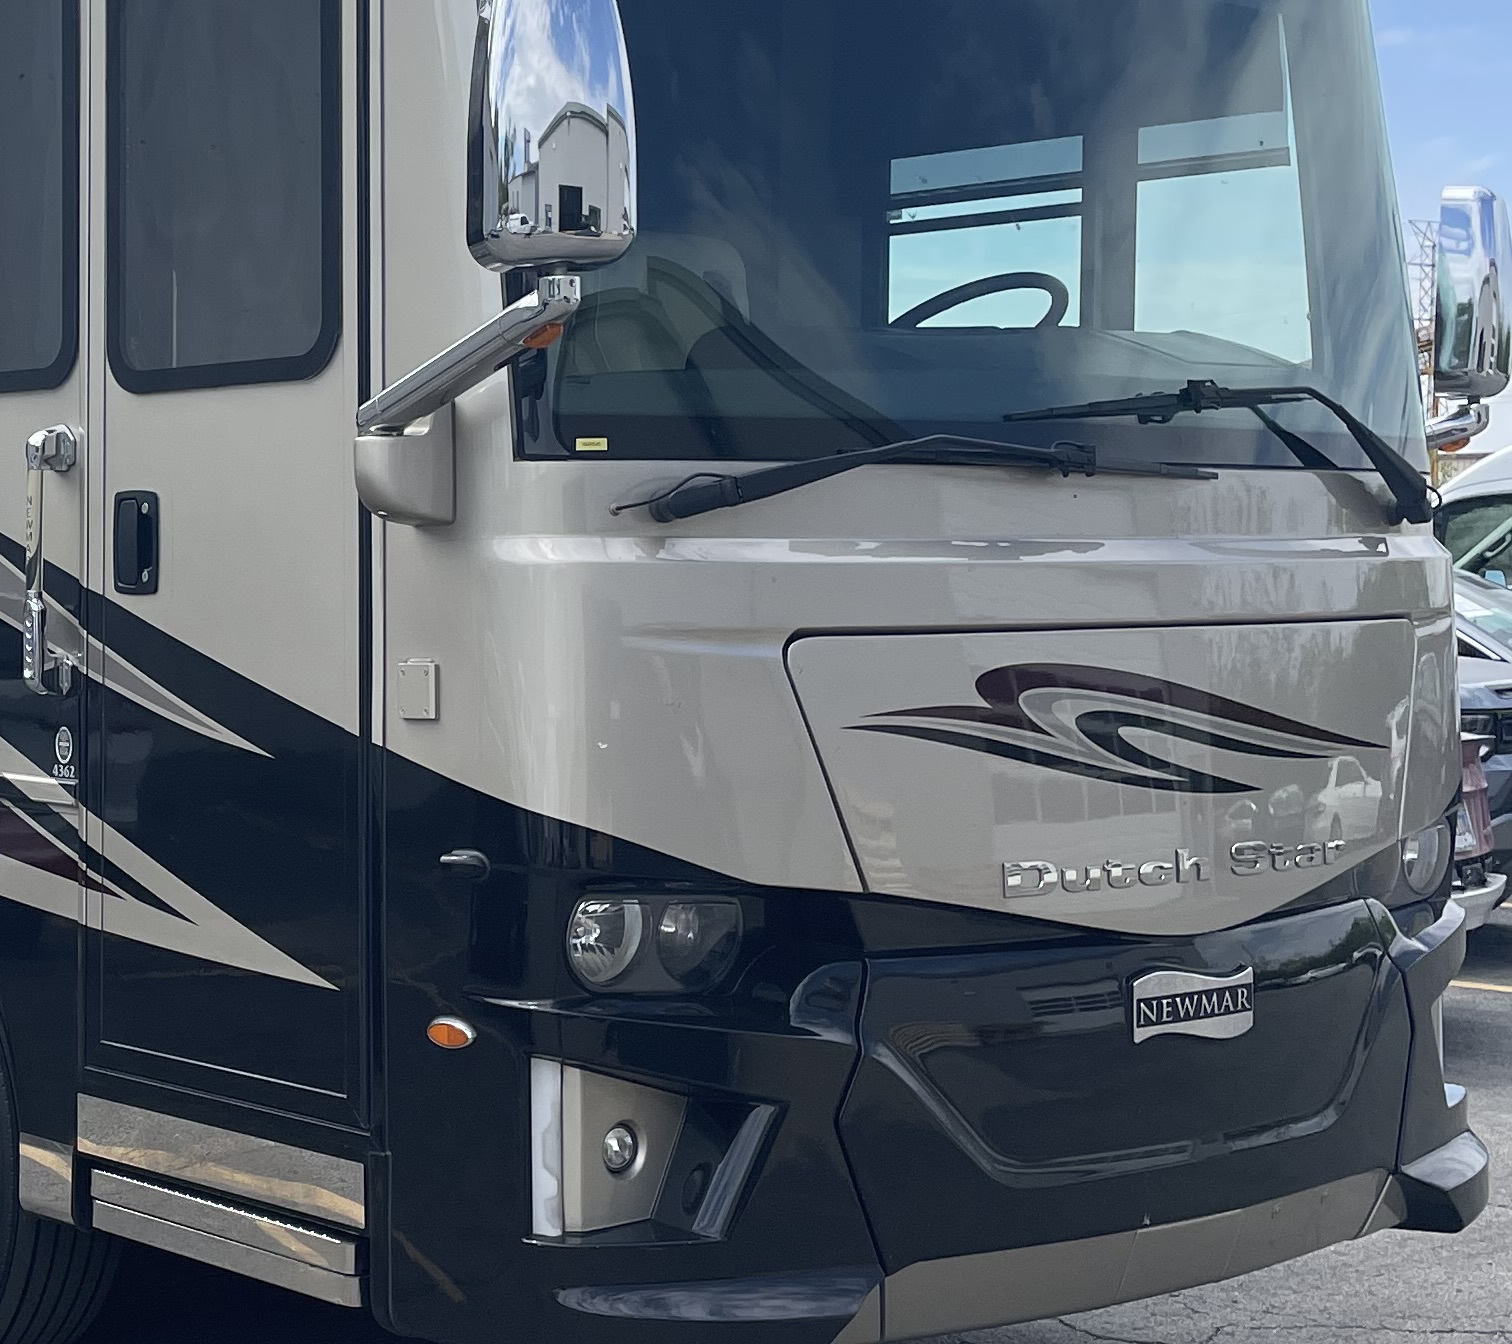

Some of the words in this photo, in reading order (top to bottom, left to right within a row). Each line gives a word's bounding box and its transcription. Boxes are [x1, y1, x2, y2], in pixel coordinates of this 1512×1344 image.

[52, 763, 76, 778] 4362
[1002, 848, 1211, 899] Dutch
[1229, 839, 1347, 877] Star
[1137, 987, 1252, 1027] NEWMAR
